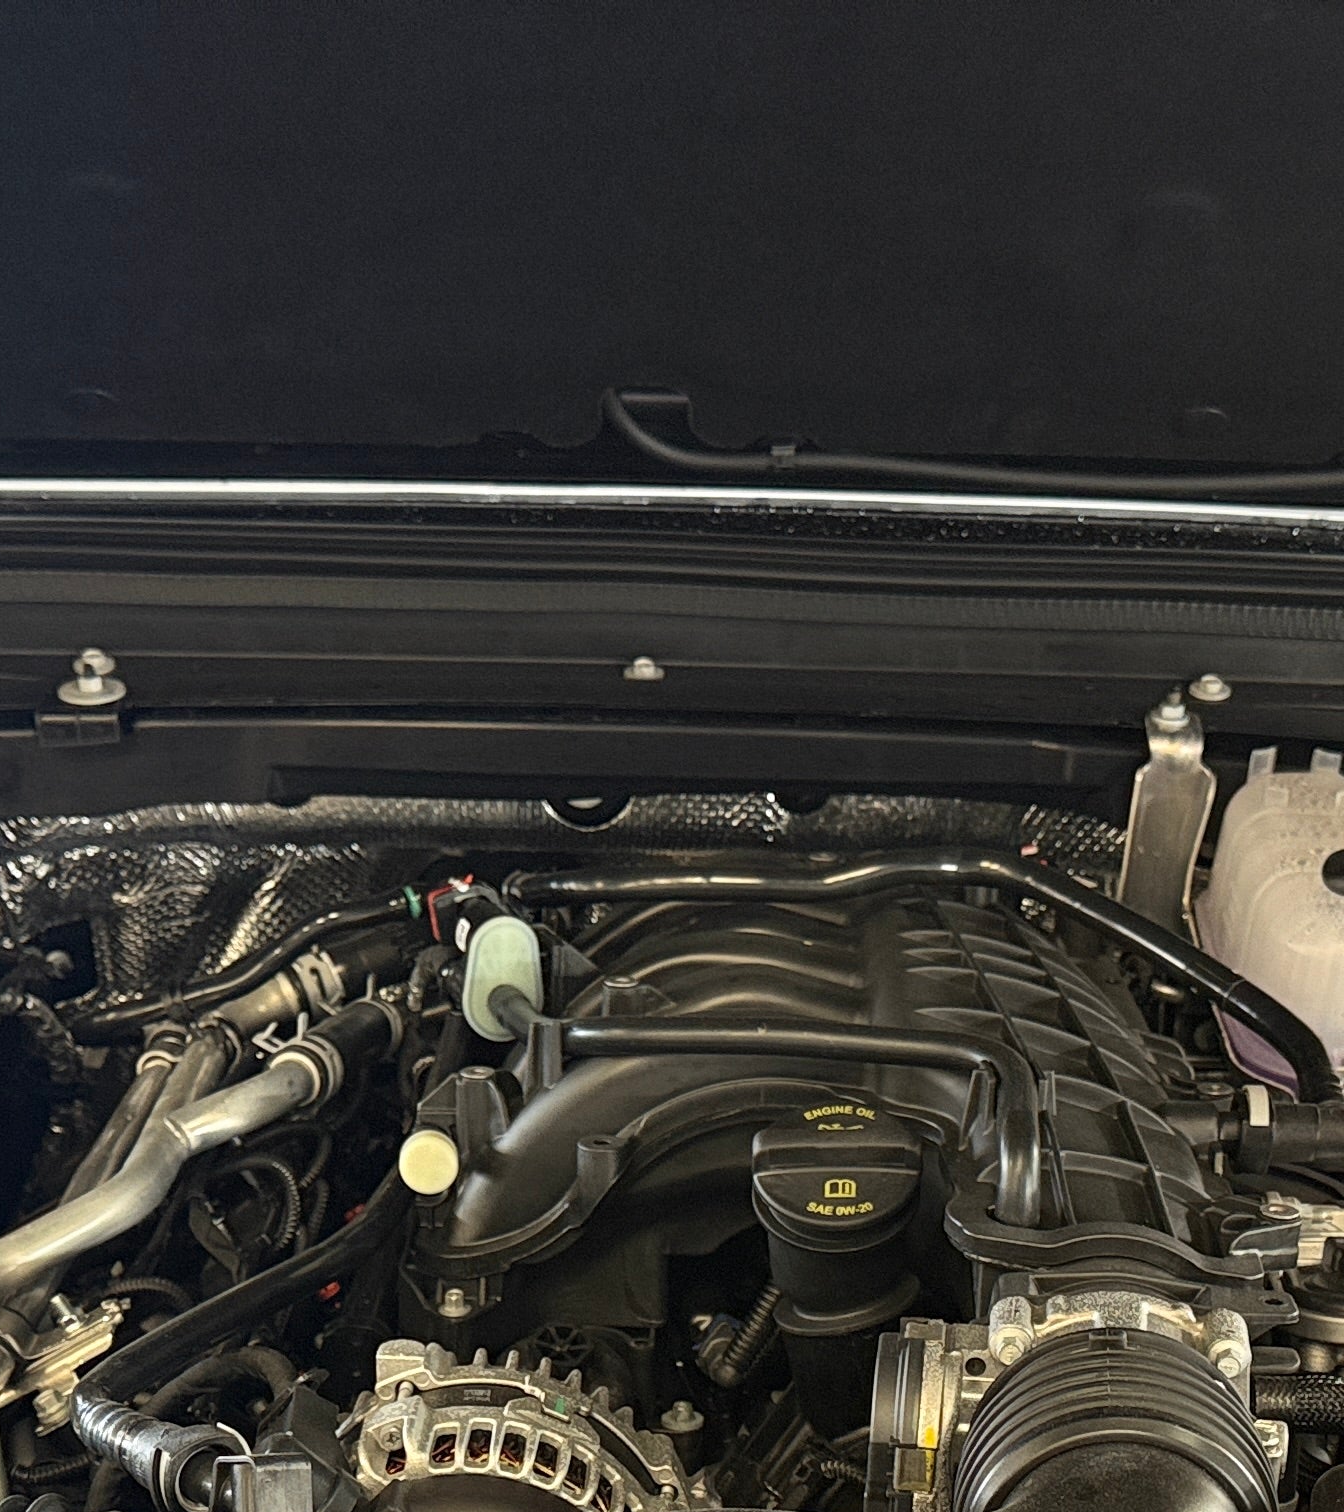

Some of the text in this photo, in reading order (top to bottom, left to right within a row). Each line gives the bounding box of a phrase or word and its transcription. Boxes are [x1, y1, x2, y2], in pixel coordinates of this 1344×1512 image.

[803, 1105, 876, 1121] ENGINE OIL
[805, 1201, 874, 1216] SAE 0W-20
